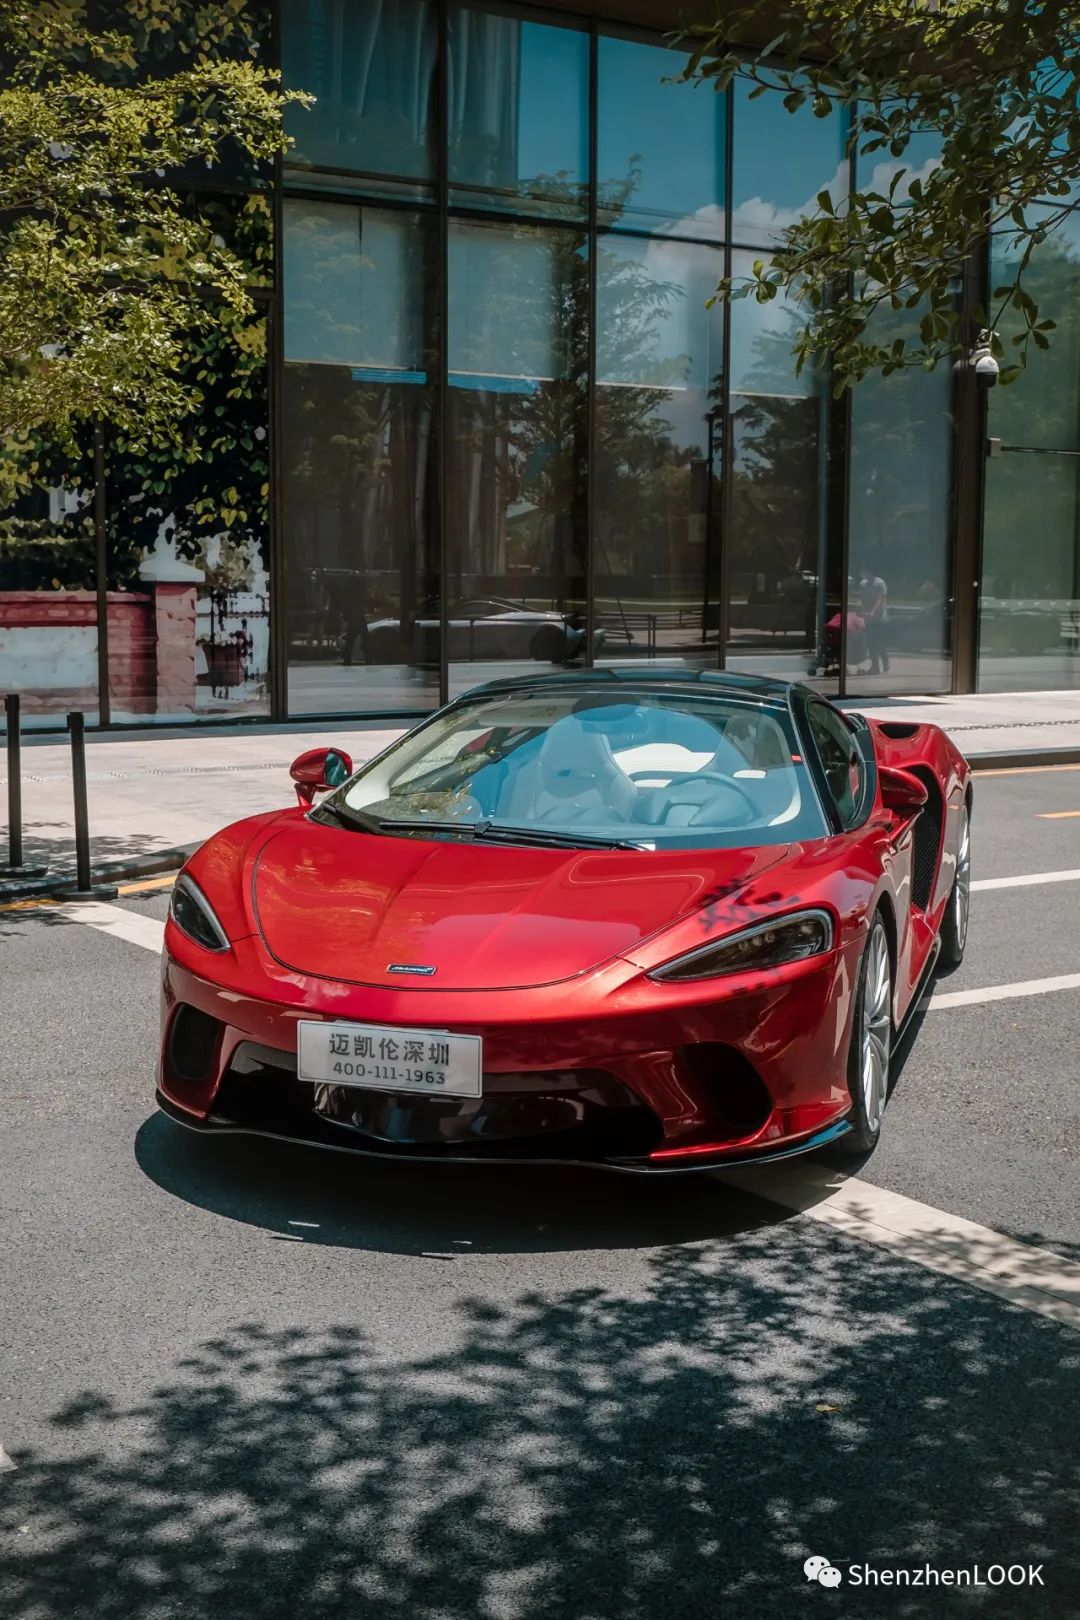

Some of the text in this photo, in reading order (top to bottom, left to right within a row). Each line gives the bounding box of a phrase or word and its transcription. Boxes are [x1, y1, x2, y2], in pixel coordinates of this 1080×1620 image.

[329, 1033, 450, 1066] 迈凯伦深圳
[333, 1062, 446, 1085] 400-111-1963
